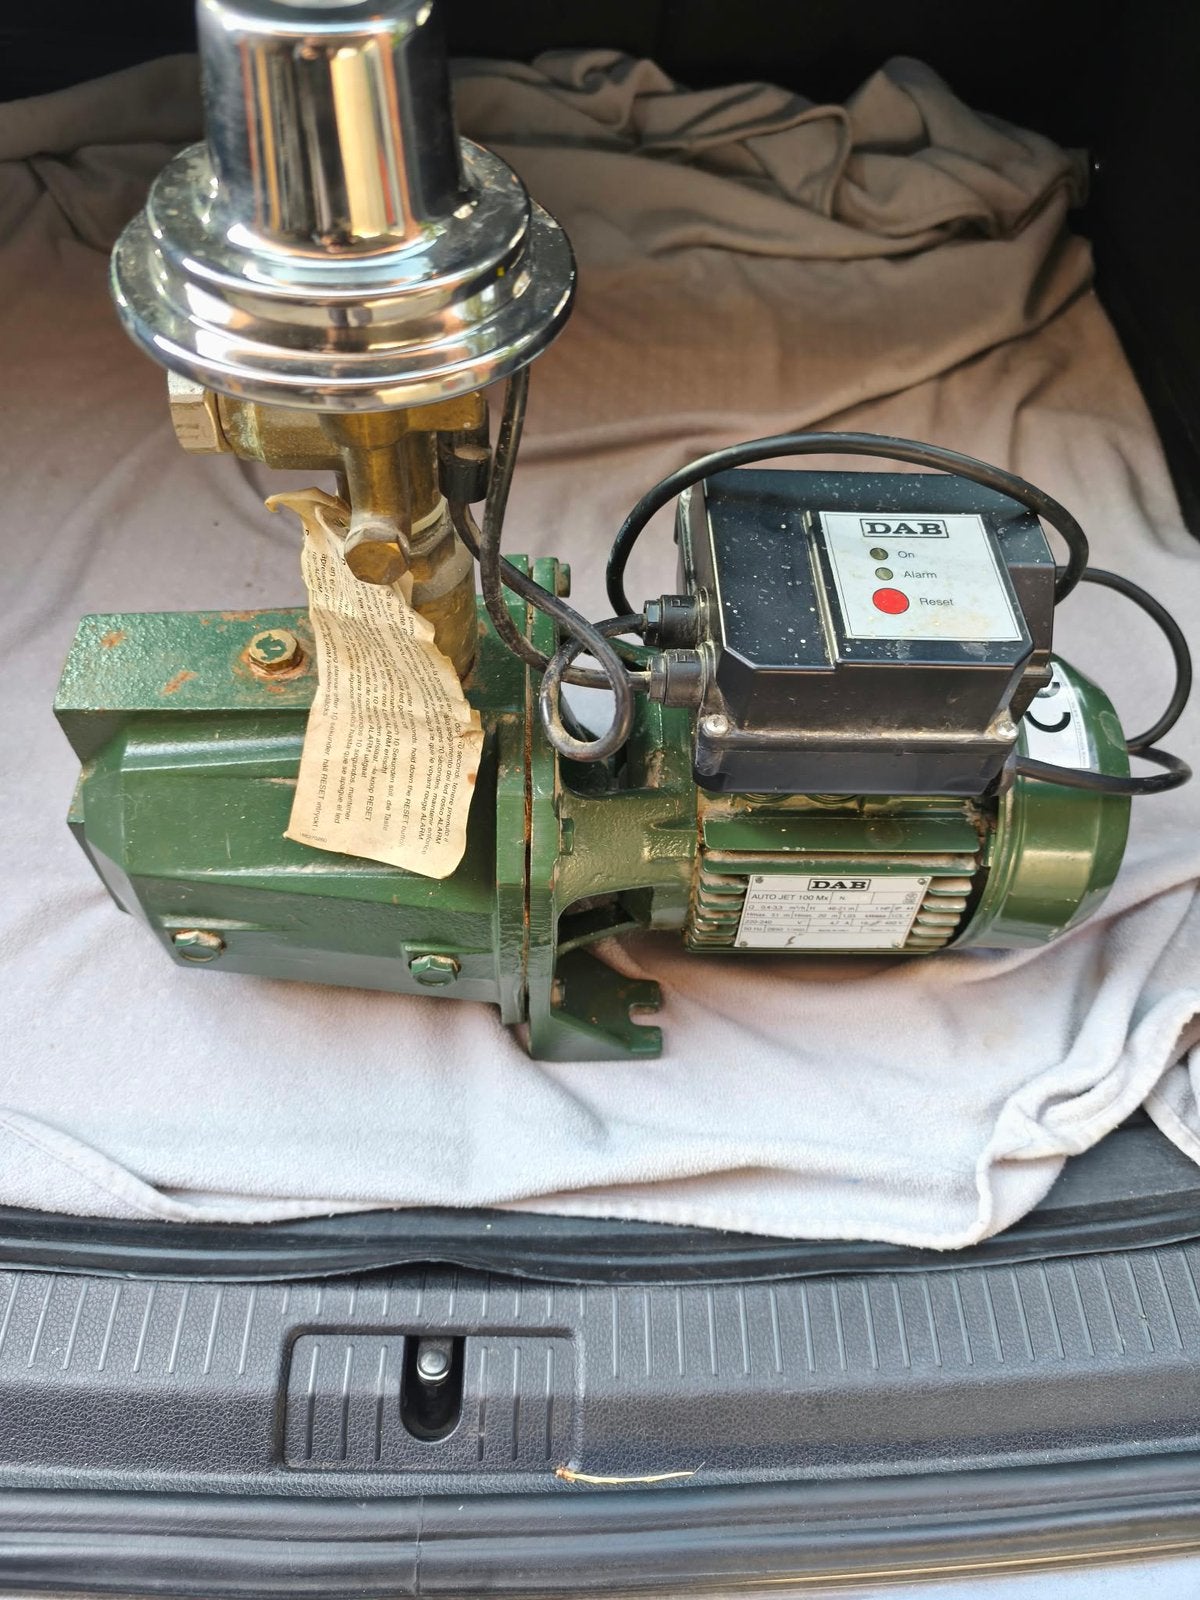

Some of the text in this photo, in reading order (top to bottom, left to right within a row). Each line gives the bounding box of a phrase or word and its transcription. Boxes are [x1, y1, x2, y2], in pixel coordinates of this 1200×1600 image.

[865, 522, 942, 535] DAB
[898, 551, 915, 559] On
[904, 570, 937, 579] Alarm
[920, 598, 954, 606] Reset
[355, 738, 362, 747] 10
[365, 724, 374, 752] ALARM
[393, 737, 400, 746] 10
[359, 753, 369, 777] uitgaat
[388, 747, 399, 782] Sekunden
[317, 773, 328, 800] RESET
[336, 776, 345, 802] apague
[425, 765, 433, 789] voyant
[344, 786, 354, 820] mantener
[420, 790, 429, 811] rouge
[448, 782, 458, 805] tenere
[364, 795, 374, 821] RESET
[401, 798, 411, 824] RESET
[417, 812, 426, 840] ALARM
[435, 816, 443, 844] ALARM
[811, 881, 867, 889] DAB
